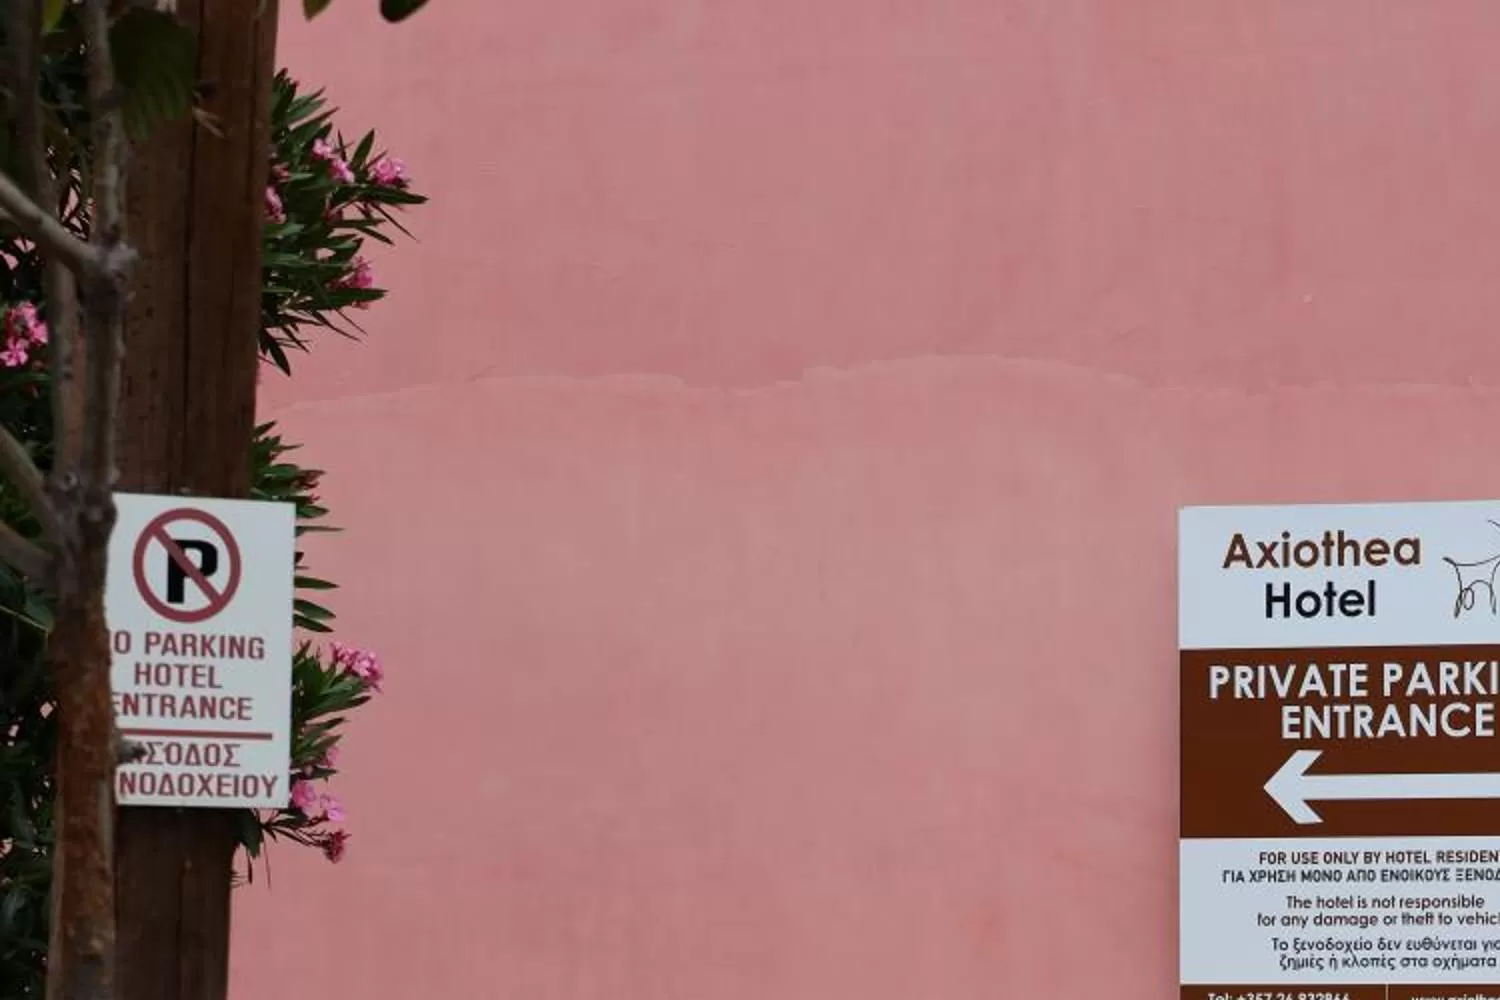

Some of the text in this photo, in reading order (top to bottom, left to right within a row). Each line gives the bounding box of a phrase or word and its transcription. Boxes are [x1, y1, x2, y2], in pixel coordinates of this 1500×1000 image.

[1222, 529, 1421, 569] Axiothea
[1265, 580, 1376, 618] Hotel
[112, 630, 265, 660] O PARKING
[134, 662, 223, 689] HOTEL
[1208, 662, 1369, 699] PRIVATE
[1281, 703, 1495, 739] ENTRANCE
[138, 741, 241, 768] ΣΟΔΟΣ
[118, 771, 278, 798] ΝΟΔΟΧΕΙΟΥ
[1259, 851, 1287, 865] FOR
[1291, 851, 1319, 865] USE
[1323, 851, 1358, 864] ONLY
[1363, 851, 1381, 864] BY
[1385, 851, 1431, 864] HOTEL
[1222, 870, 1245, 883] ΓΙΑ
[1249, 870, 1296, 883] ΧΡΗΣΗ
[1301, 869, 1343, 883] ΜΟΝΟ
[1346, 869, 1376, 882] ΑΠΟ
[1380, 868, 1450, 882] ΕΝΟΙΚΟΥΣ
[1286, 894, 1485, 910] The hotel is not responsible
[1257, 912, 1276, 926] for
[1281, 915, 1309, 929] any
[1313, 912, 1378, 928] damage
[1383, 915, 1398, 926] or
[1401, 912, 1434, 925] theft
[1438, 912, 1453, 925] to
[1272, 938, 1289, 951] Το
[1293, 936, 1373, 954] ξενοδοχείο
[1377, 937, 1401, 950] δεν
